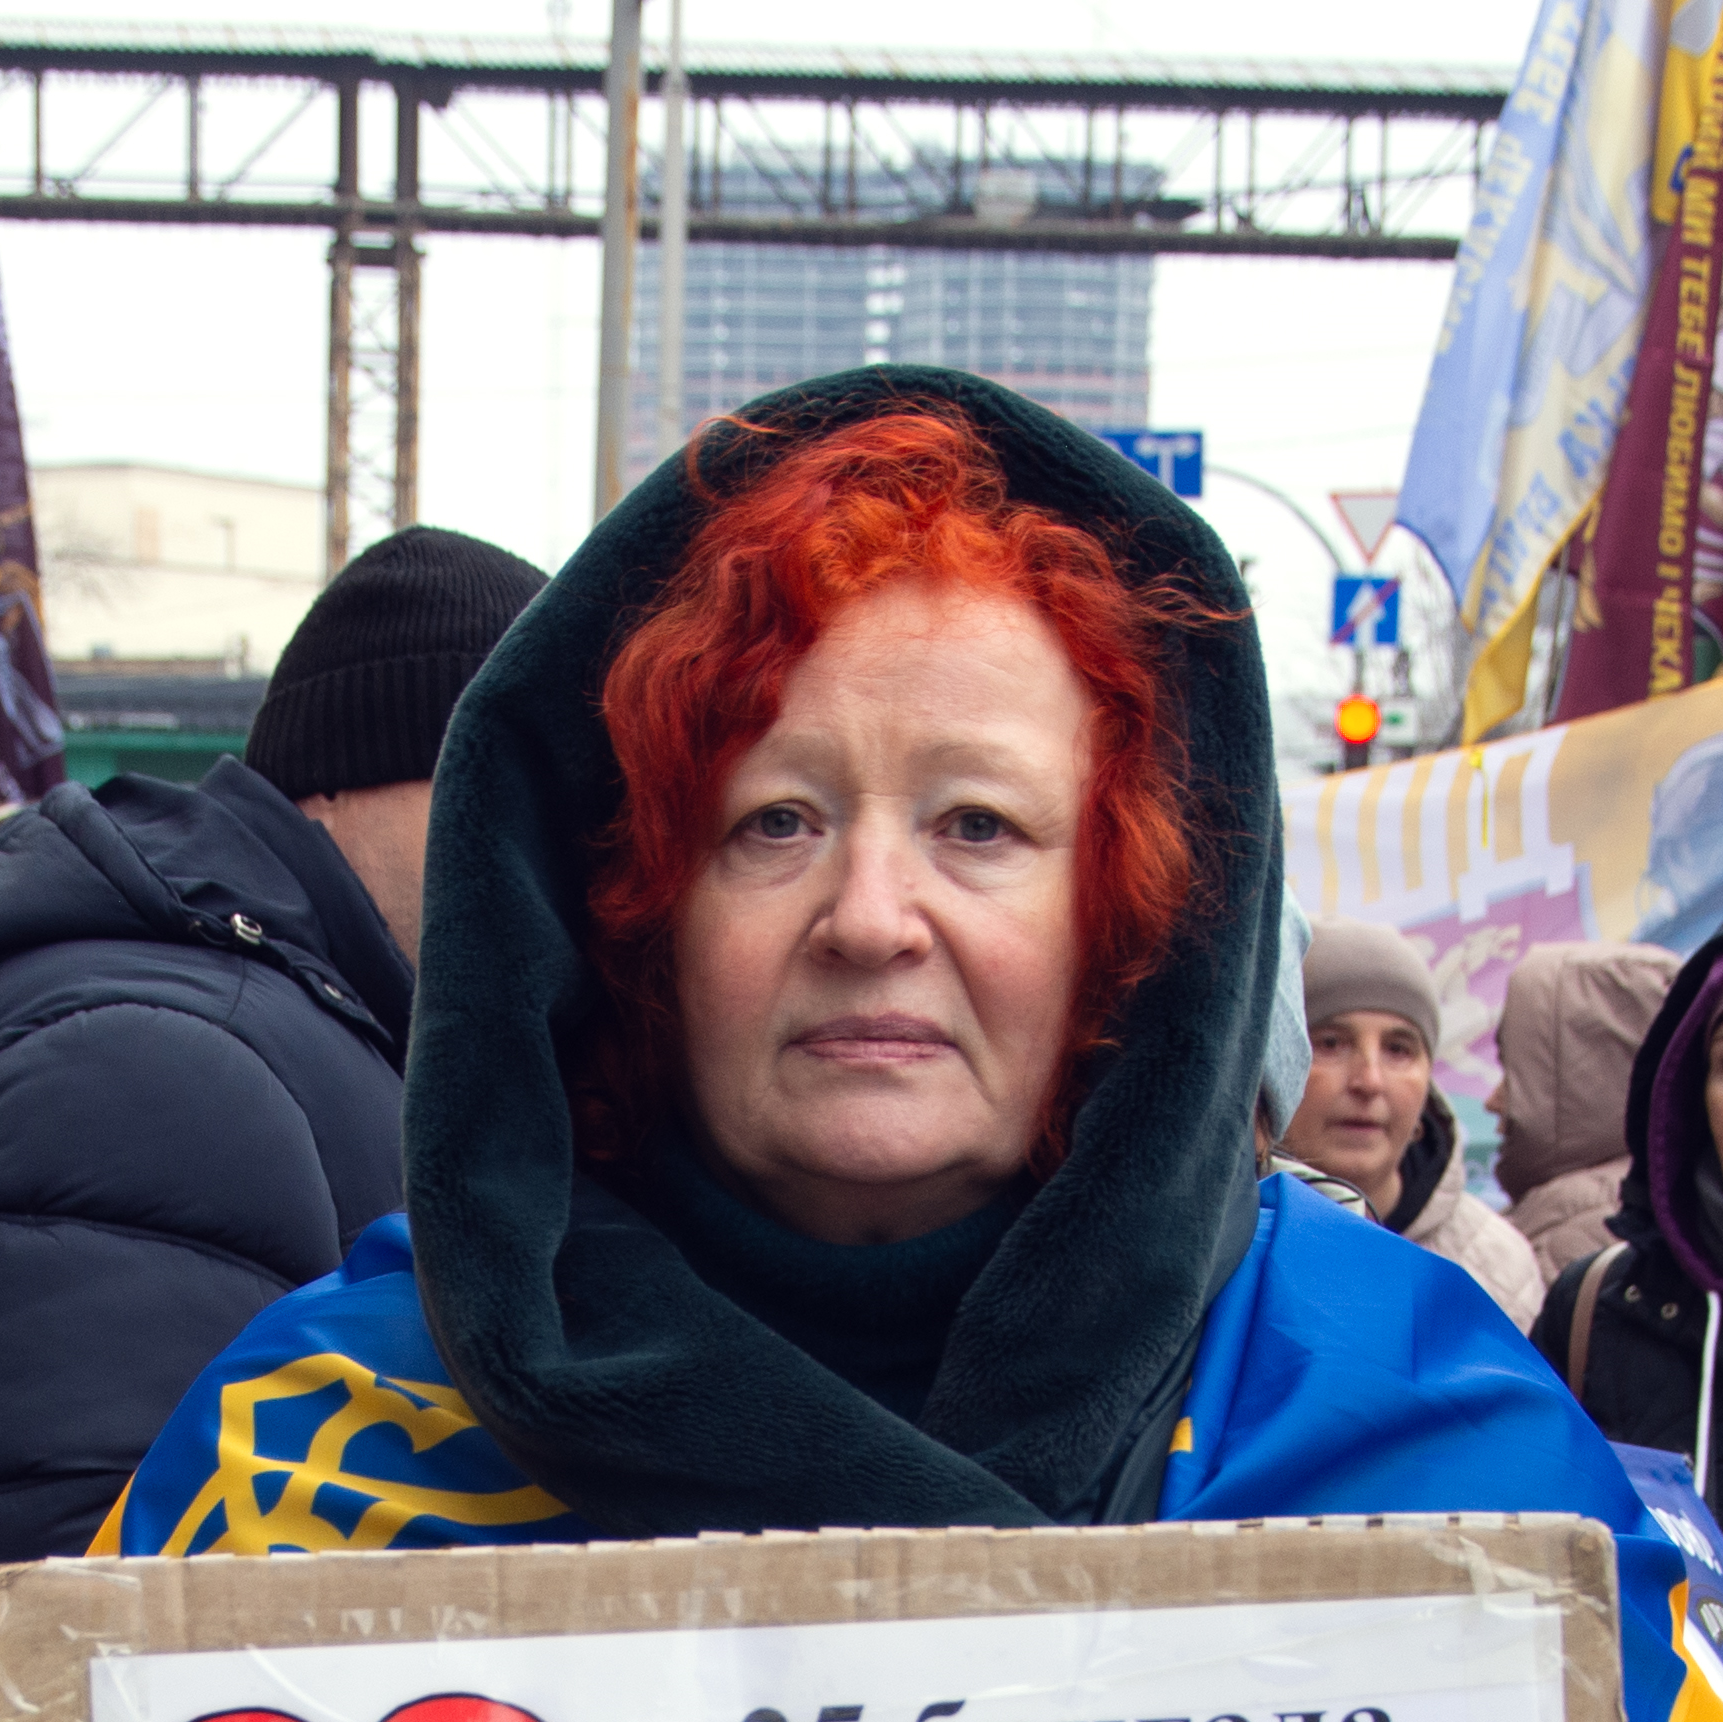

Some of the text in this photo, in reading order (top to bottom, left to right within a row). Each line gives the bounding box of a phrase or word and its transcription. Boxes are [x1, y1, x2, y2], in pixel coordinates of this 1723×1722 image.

[1681, 176, 1720, 247] МИ
[1674, 256, 1713, 358] ТЕБЕ
[1657, 360, 1704, 557] ЛЮБИМО
[1647, 585, 1685, 697] ЧЕКА
